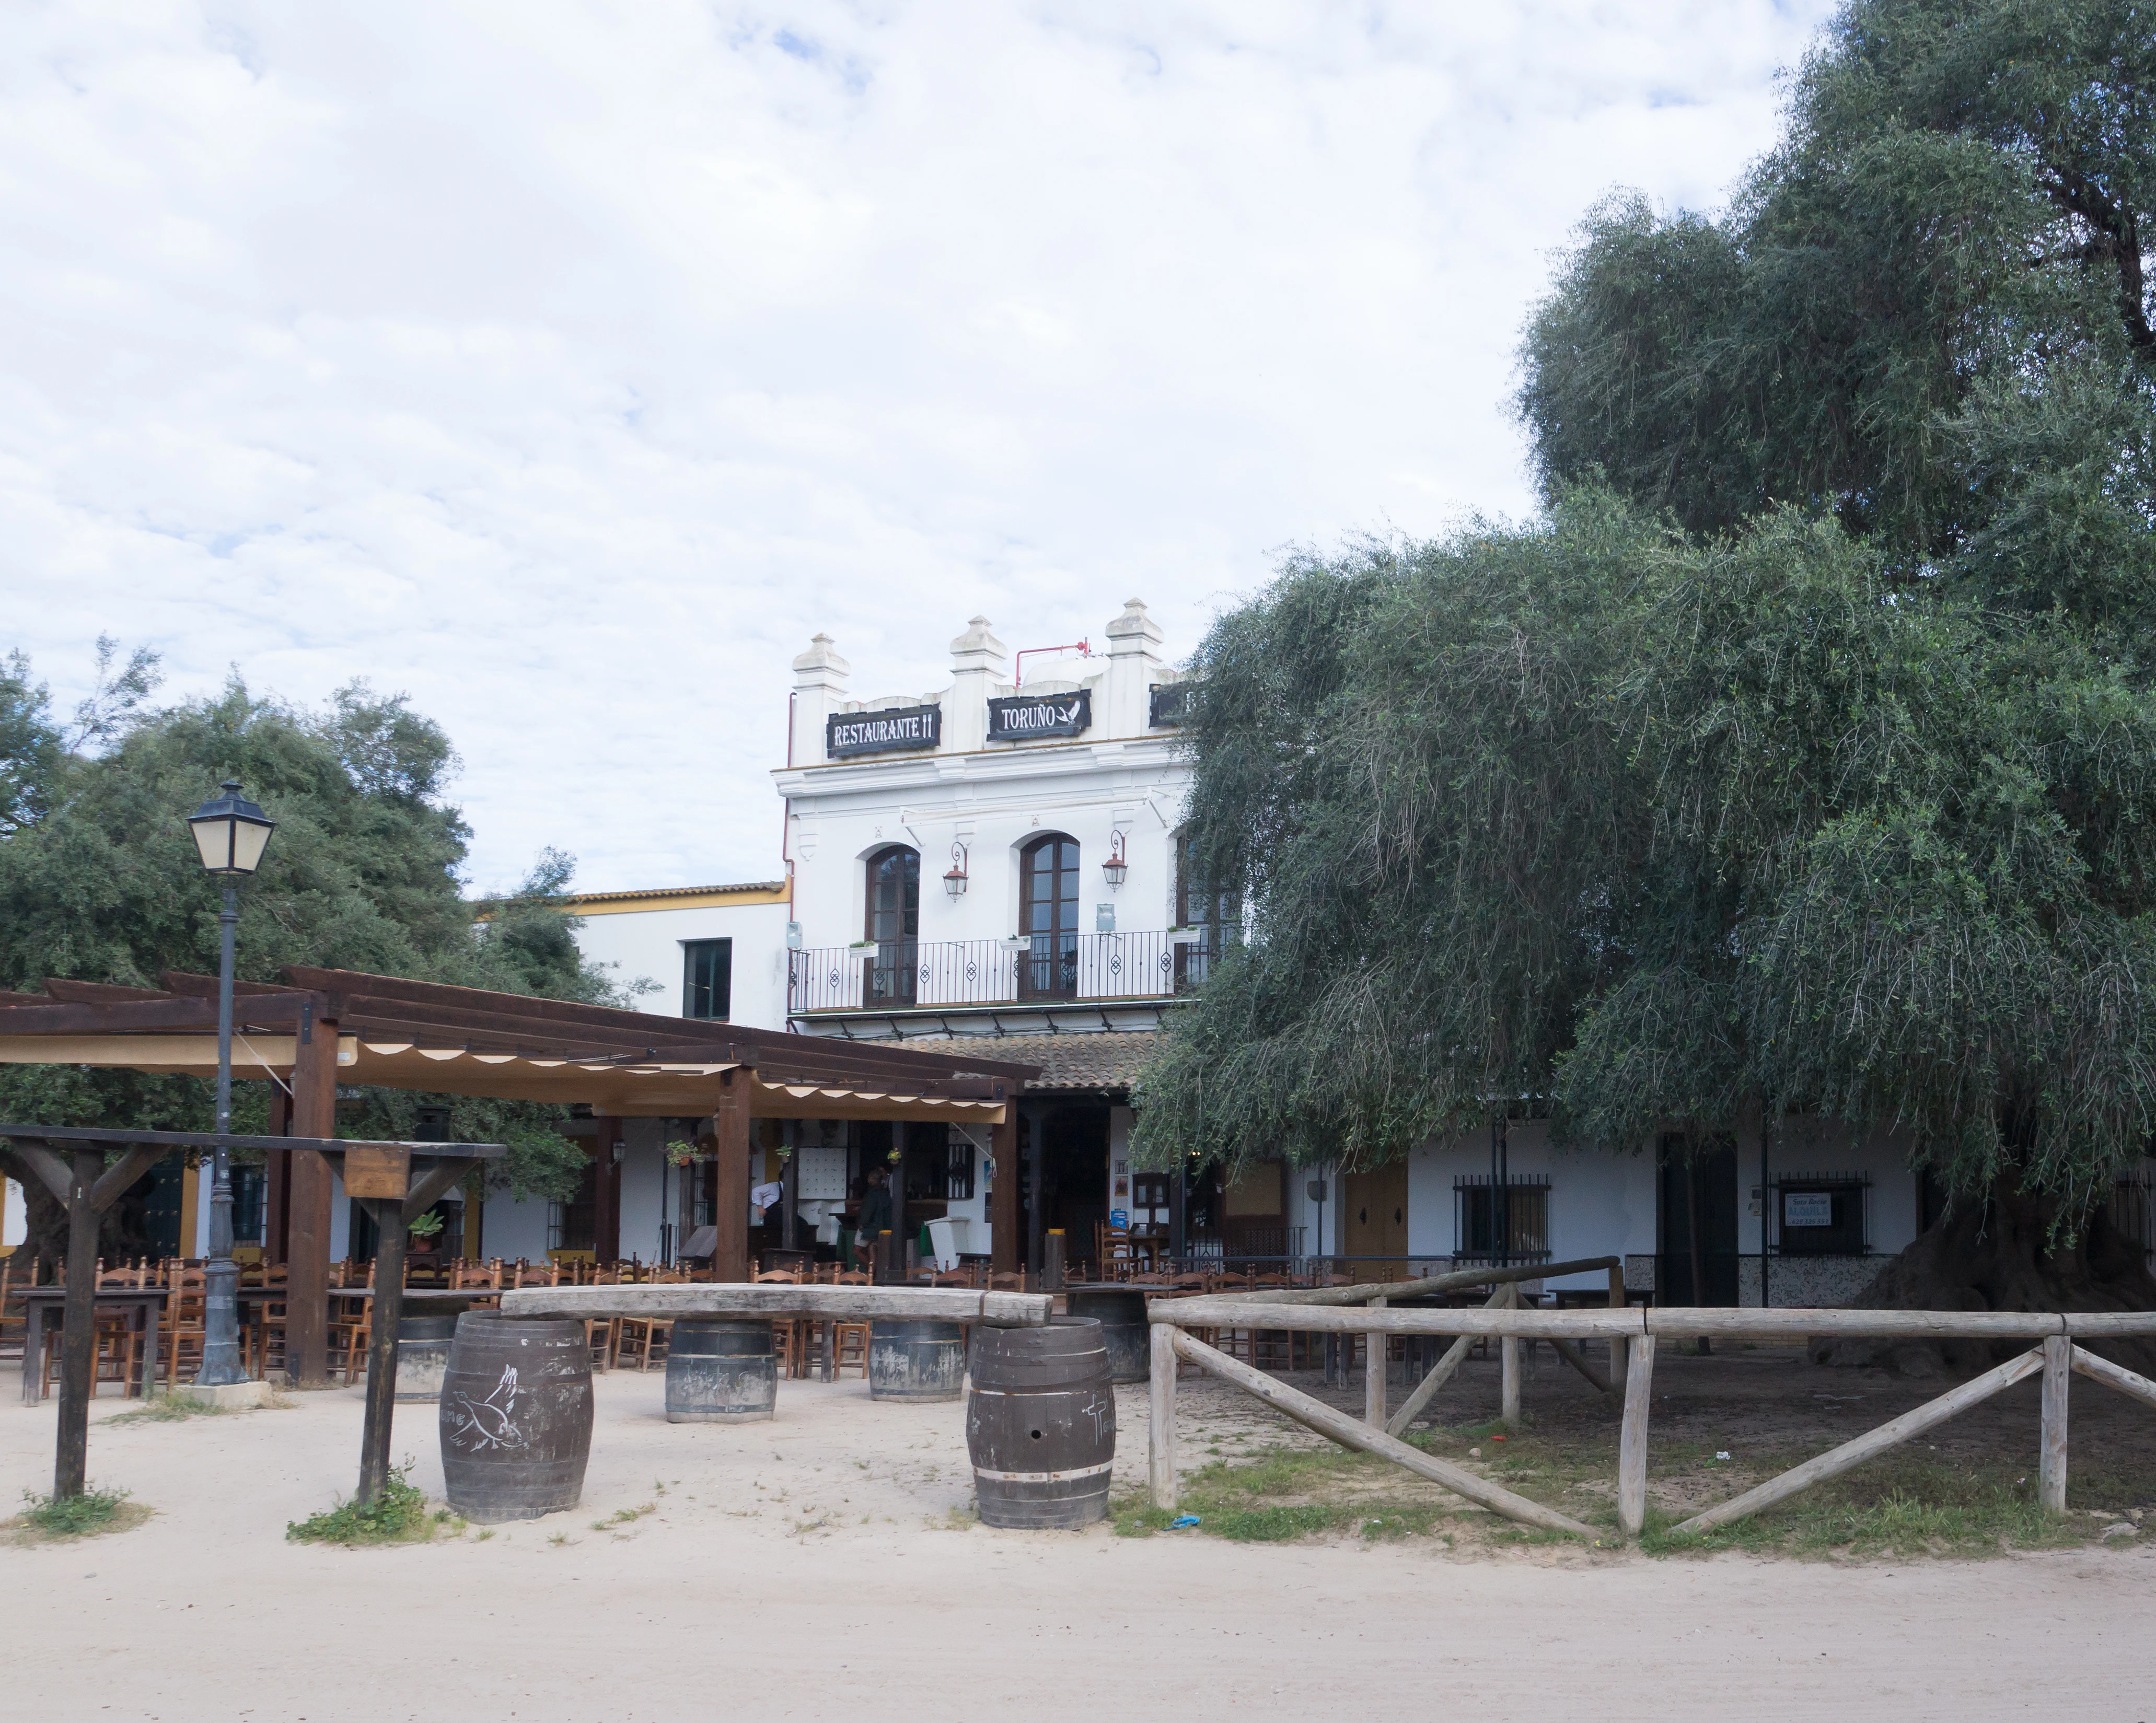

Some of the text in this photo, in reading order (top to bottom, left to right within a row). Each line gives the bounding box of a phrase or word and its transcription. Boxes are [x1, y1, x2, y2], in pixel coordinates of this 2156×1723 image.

[1001, 703, 1056, 730] TORUÑO
[834, 717, 920, 747] RESTAURANTE
[1789, 1206, 1828, 1216] ALQUILA
